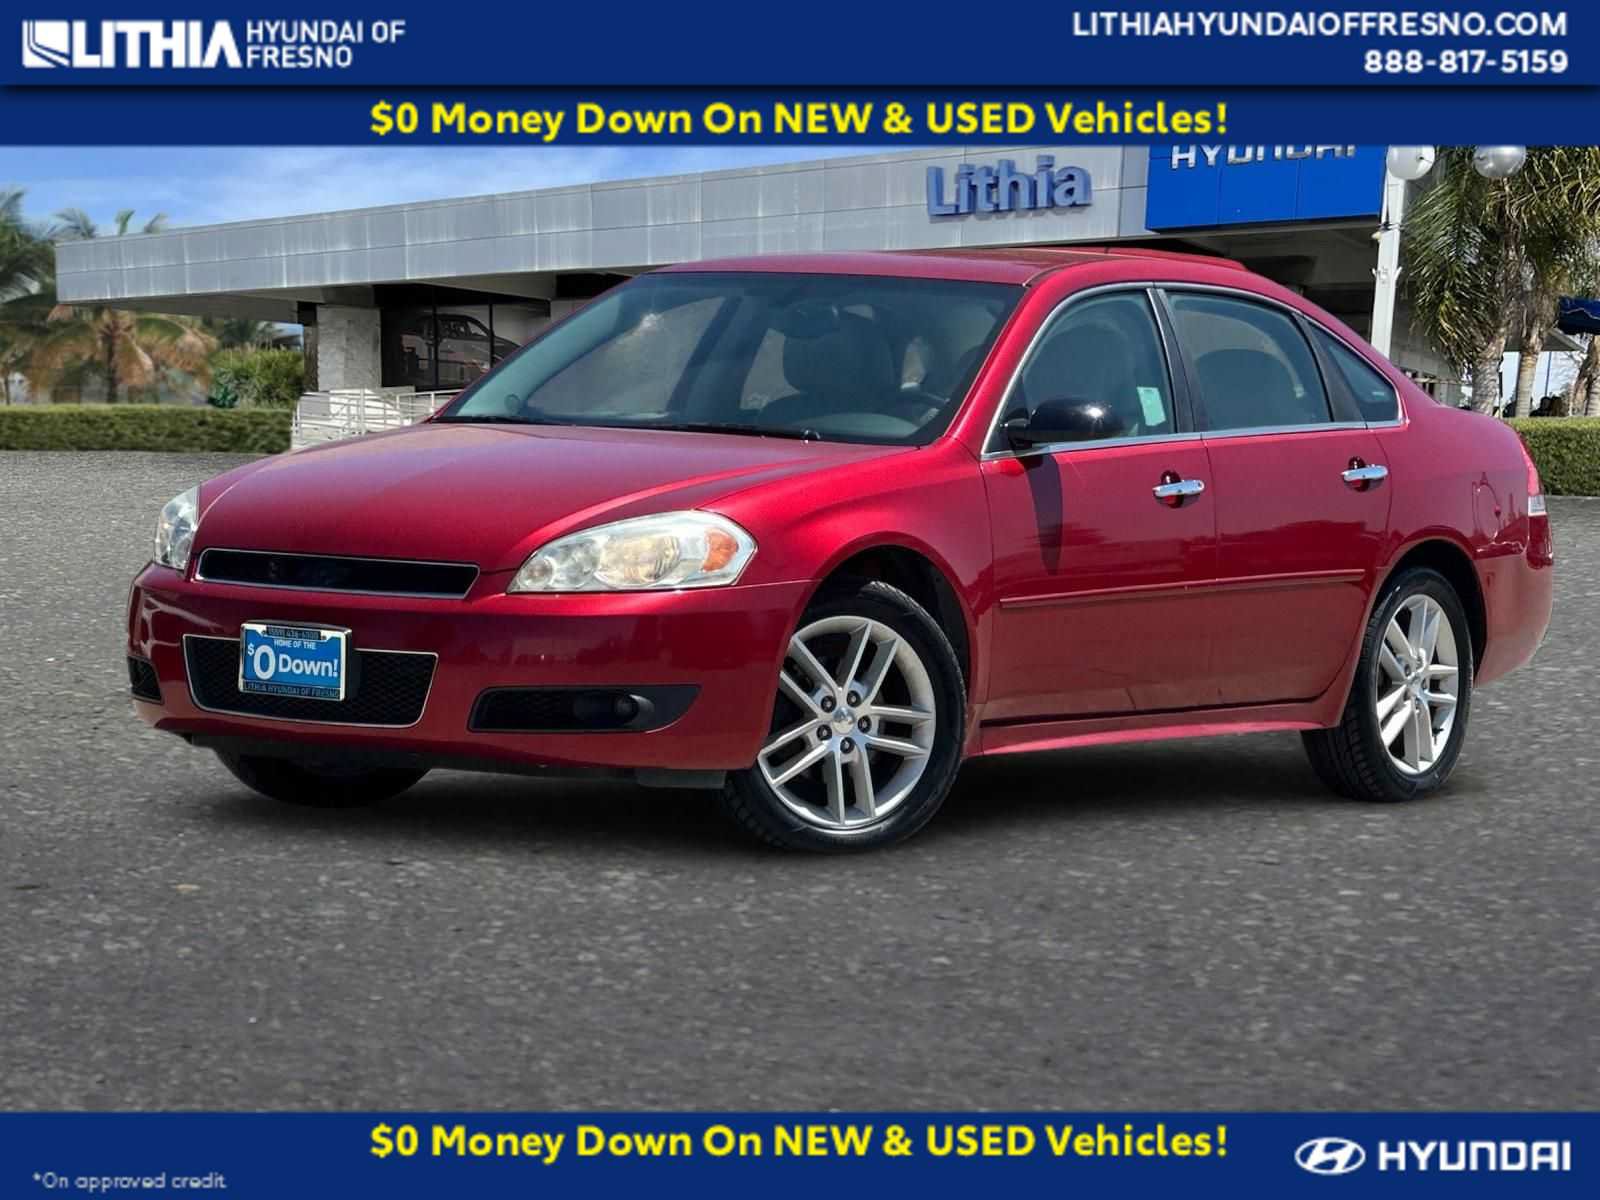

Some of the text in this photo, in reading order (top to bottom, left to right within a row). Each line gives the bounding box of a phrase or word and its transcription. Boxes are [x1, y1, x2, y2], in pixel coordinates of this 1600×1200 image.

[926, 154, 1092, 217] Lithia
[273, 639, 317, 650] HOME OF THE
[278, 653, 338, 678] Down!
